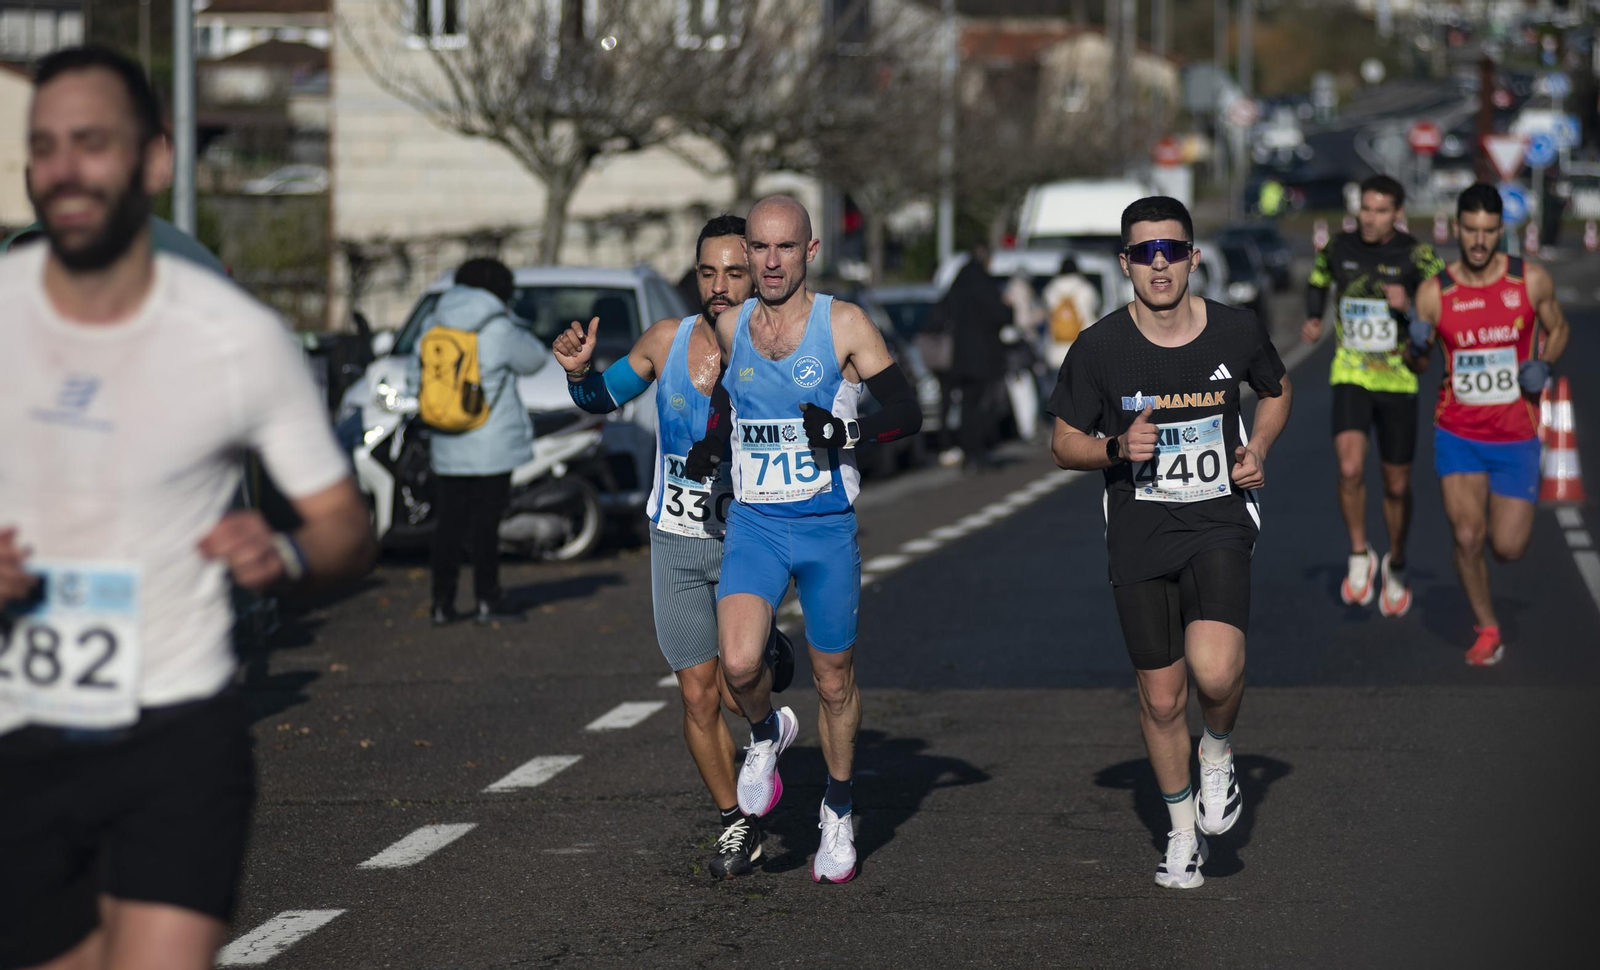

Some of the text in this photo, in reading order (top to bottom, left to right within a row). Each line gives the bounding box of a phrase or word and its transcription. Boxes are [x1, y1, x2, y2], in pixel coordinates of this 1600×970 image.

[1345, 319, 1391, 340] 303
[1457, 329, 1477, 347] LA
[1456, 369, 1513, 394] 308
[742, 425, 780, 443] XXII
[1154, 428, 1181, 447] XII
[750, 450, 821, 486] 715
[1135, 449, 1221, 488] 440
[665, 483, 735, 523] 330
[0, 624, 119, 689] 82
